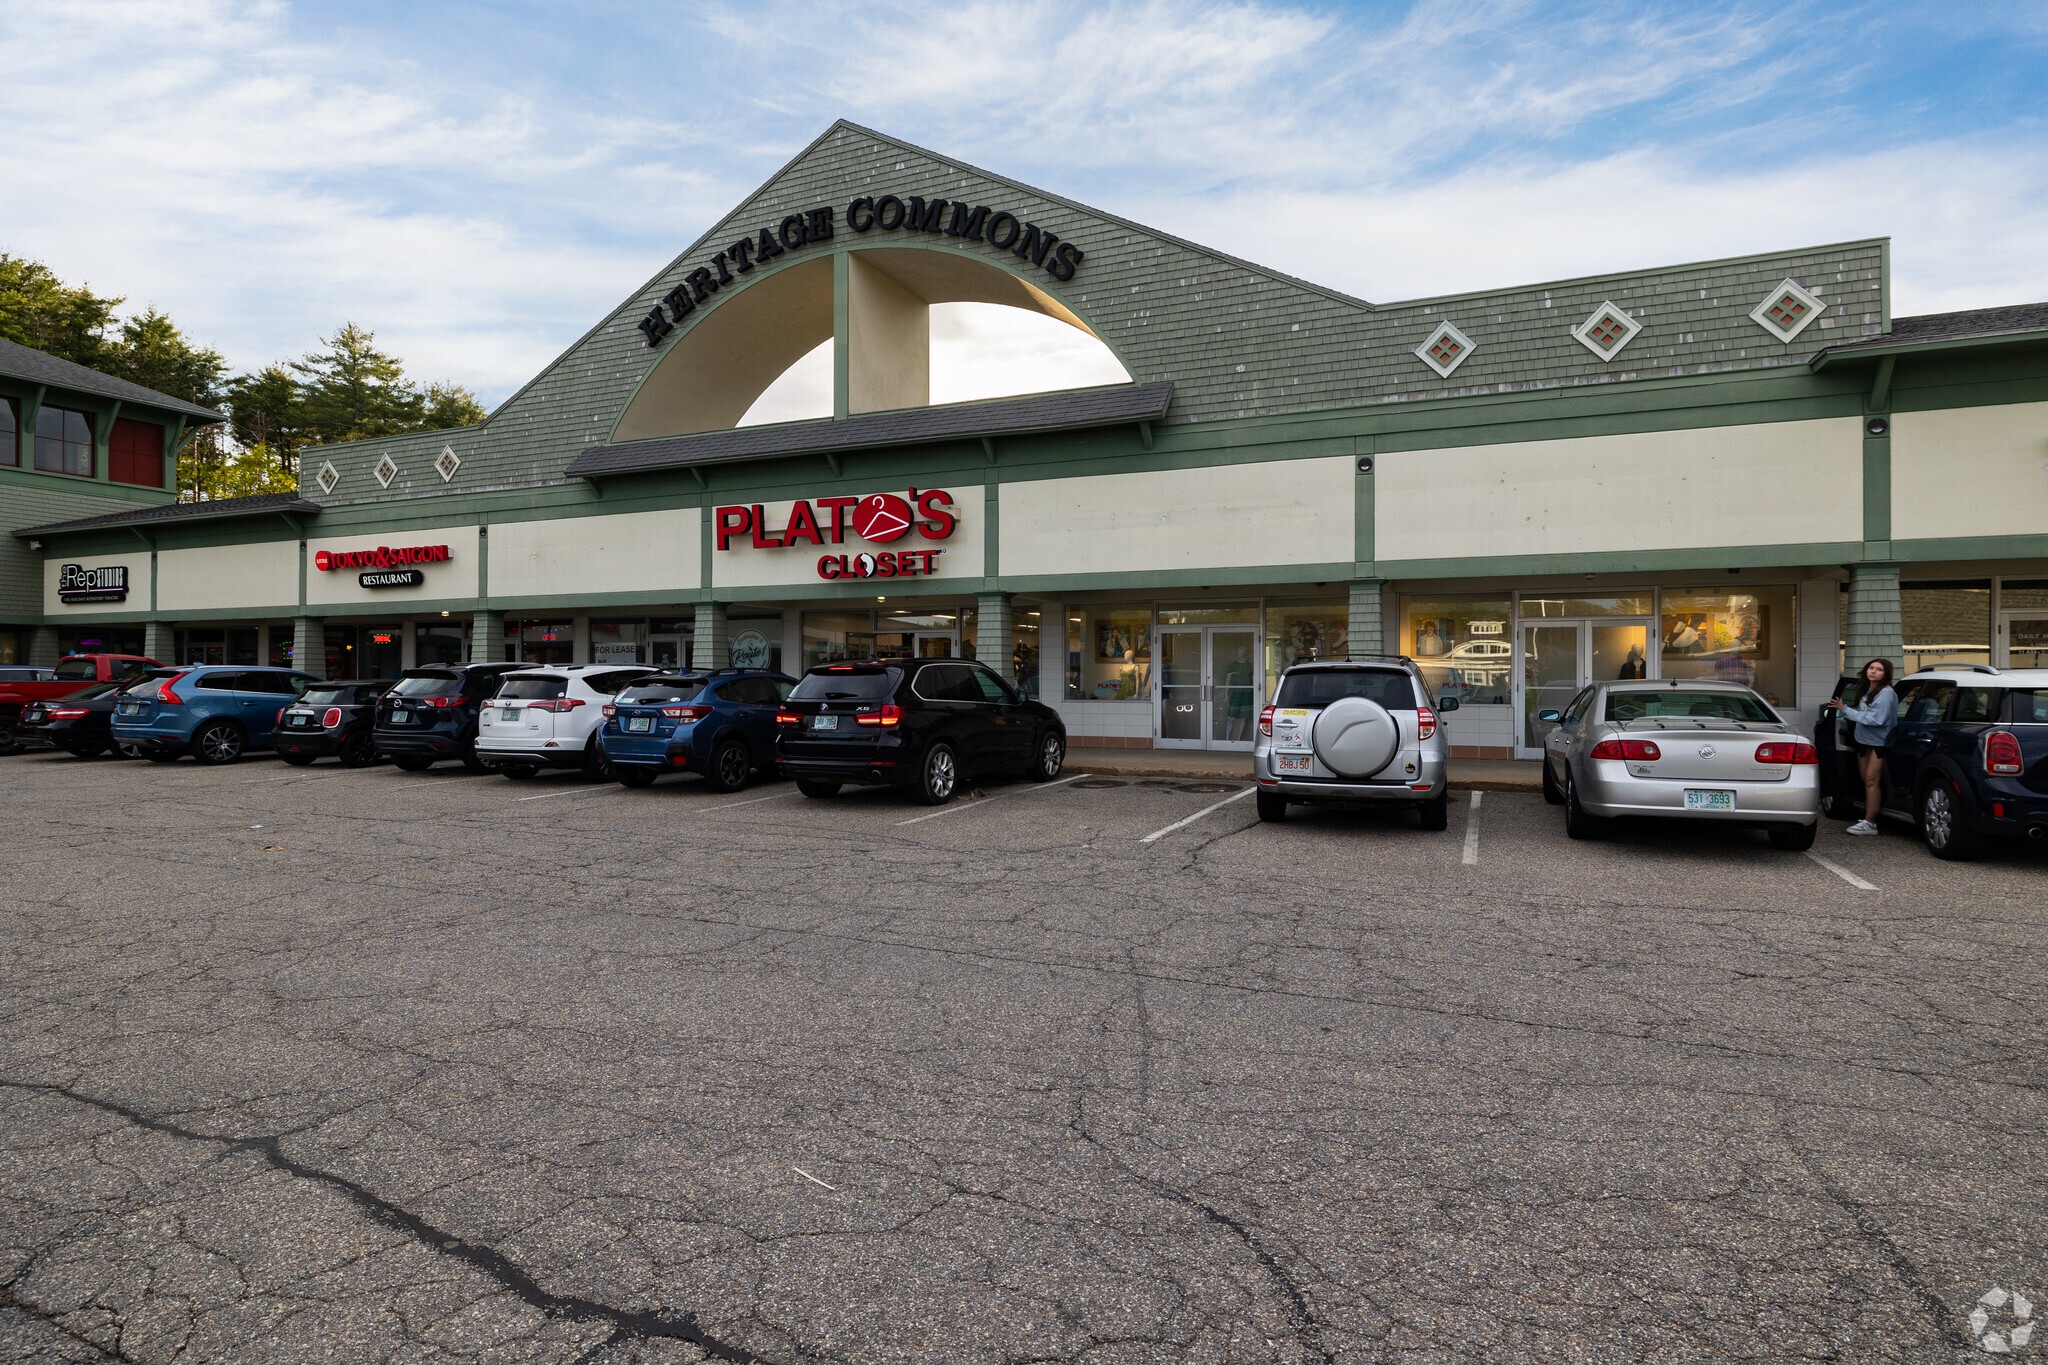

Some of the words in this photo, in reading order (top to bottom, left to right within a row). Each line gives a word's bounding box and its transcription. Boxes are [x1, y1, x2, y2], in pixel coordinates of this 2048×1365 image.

[637, 205, 834, 348] HERITAGE
[846, 195, 1085, 282] COMMONS
[715, 486, 956, 551] PLATO'S
[817, 550, 937, 580] CLOSET
[66, 565, 97, 593] Rep
[96, 567, 124, 588] STUDIOS
[362, 572, 412, 586] RESTAURANT
[595, 646, 610, 654] FOR
[611, 645, 636, 654] LEASE
[732, 647, 761, 665] Route
[1279, 760, 1299, 770] 2HBJ
[1299, 760, 1310, 770] 50
[1688, 793, 1703, 804] 531
[1709, 793, 1730, 804] 3693
